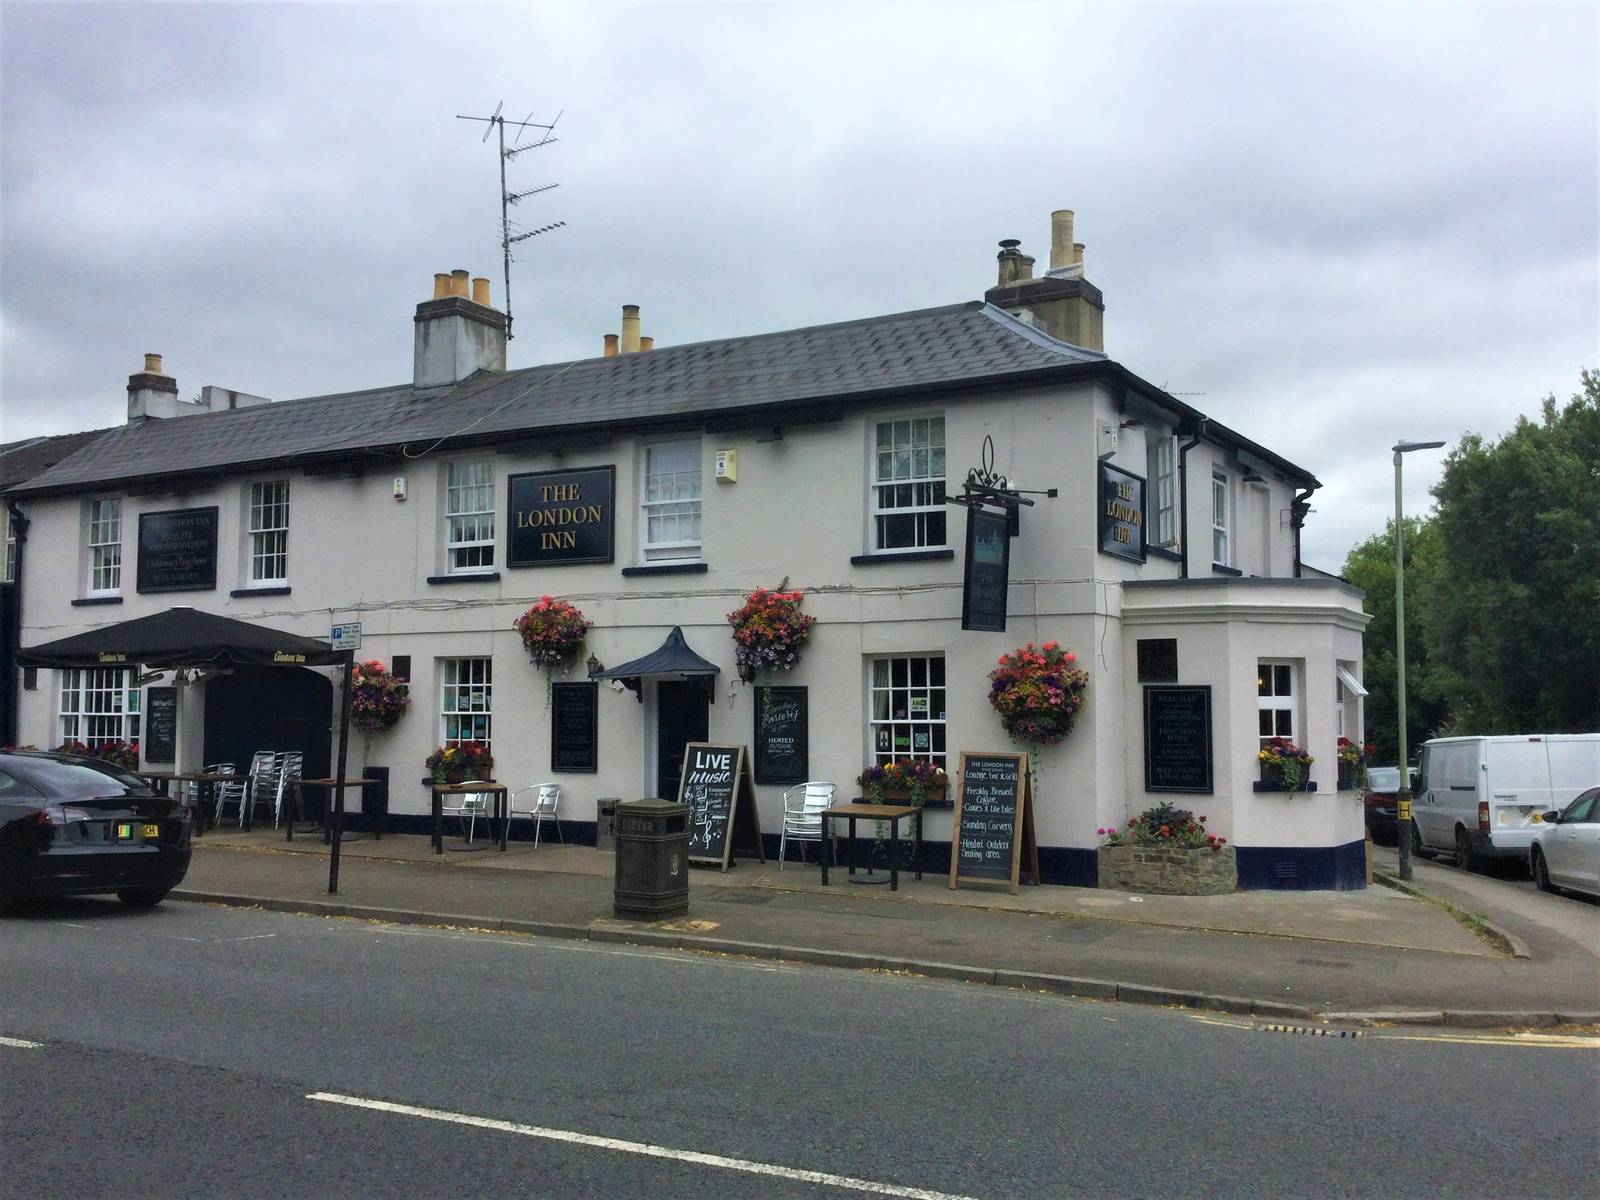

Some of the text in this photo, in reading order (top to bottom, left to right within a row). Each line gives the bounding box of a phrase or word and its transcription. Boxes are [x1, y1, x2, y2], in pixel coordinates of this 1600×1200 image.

[541, 483, 580, 503] THE
[1114, 480, 1135, 501] THE
[517, 505, 604, 528] LONDON
[1107, 500, 1142, 527] LONDON
[541, 530, 577, 550] INN
[1114, 525, 1133, 544] INN
[696, 751, 730, 770] LIVE
[966, 786, 989, 798] Freshly
[622, 818, 654, 832] LITTER
[987, 820, 1014, 835] Carvery
